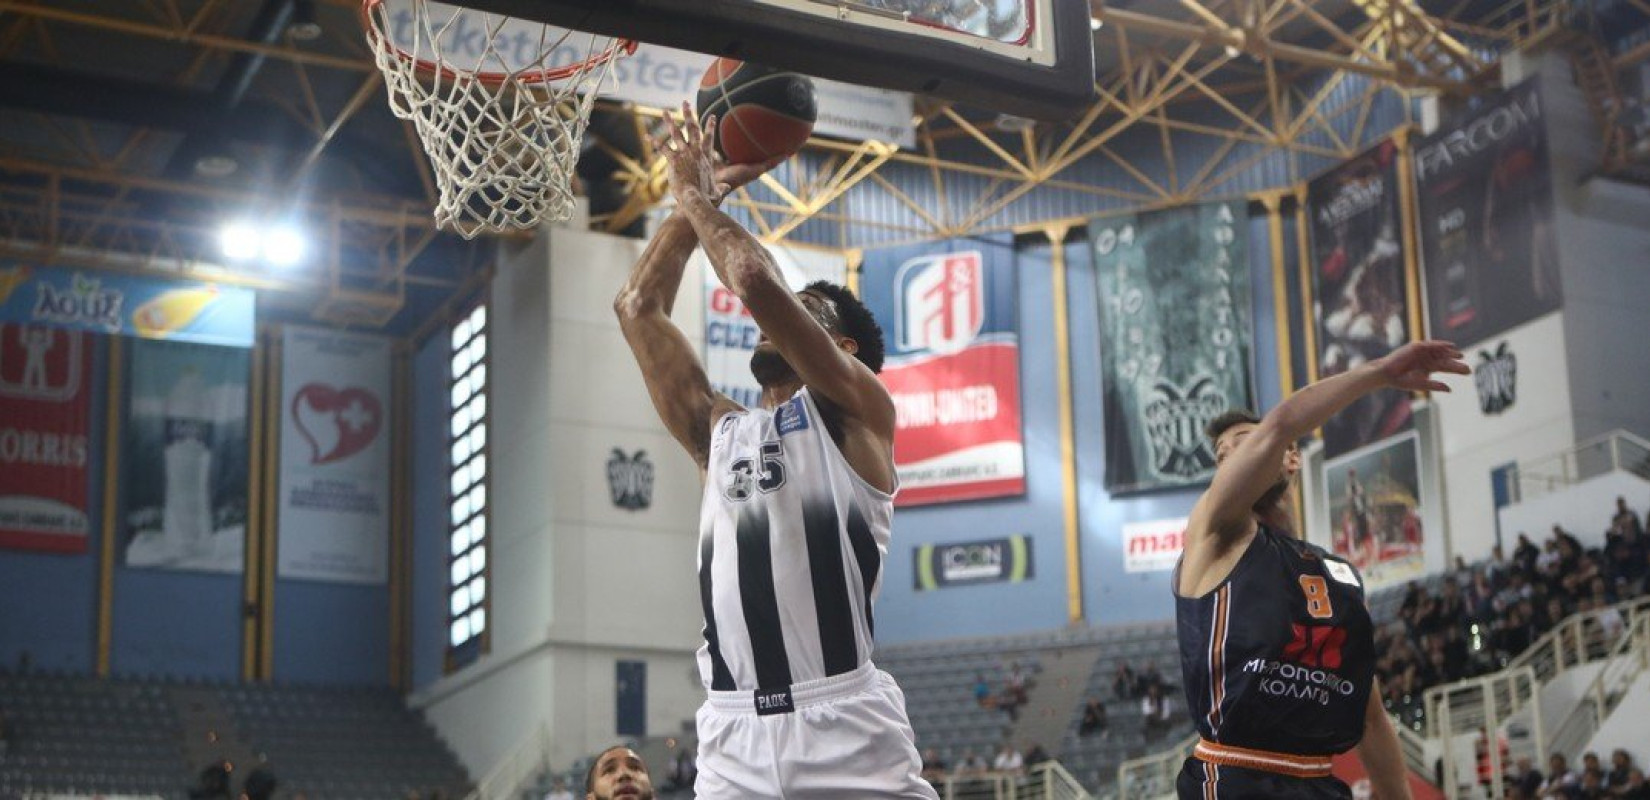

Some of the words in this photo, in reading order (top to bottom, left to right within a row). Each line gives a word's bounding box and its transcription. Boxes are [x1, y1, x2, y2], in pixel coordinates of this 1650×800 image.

[393, 9, 698, 93] tcketmster
[1416, 89, 1540, 182] FARCOM
[0, 428, 88, 467] ORRIS
[723, 440, 787, 503] 35
[1300, 574, 1333, 618] 8
[757, 692, 789, 709] PAOK
